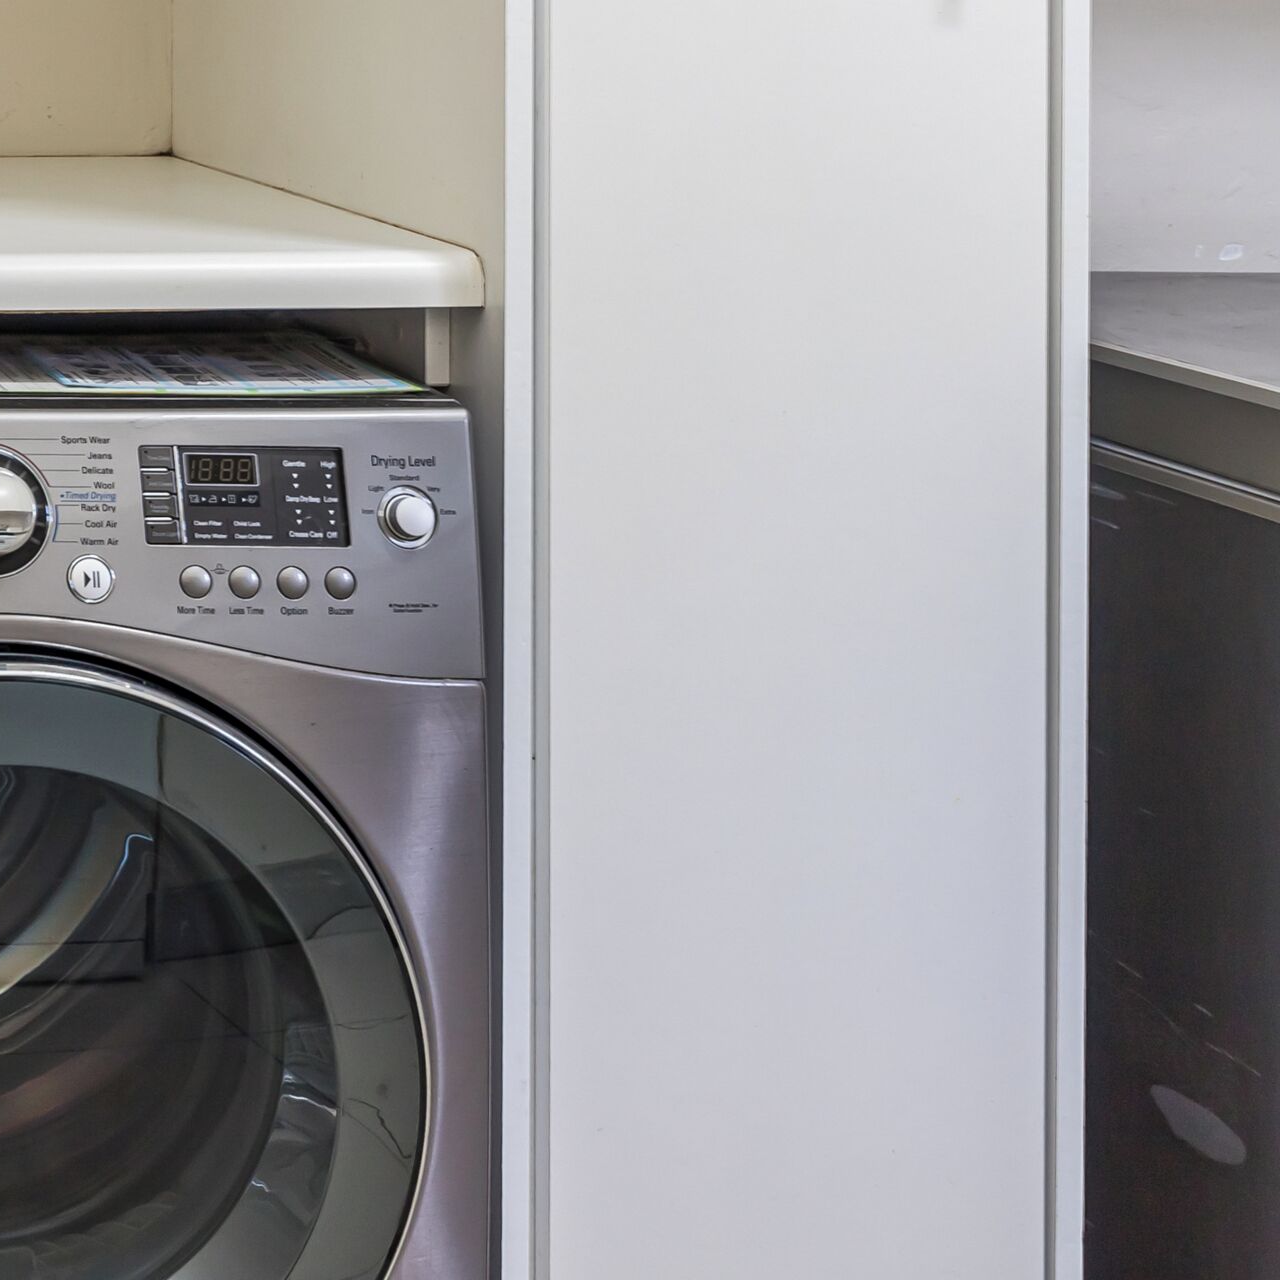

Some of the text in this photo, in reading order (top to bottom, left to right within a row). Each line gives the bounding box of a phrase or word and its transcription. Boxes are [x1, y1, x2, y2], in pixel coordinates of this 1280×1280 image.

[60, 436, 111, 445] Sports Wear
[87, 452, 112, 460] Jeans
[370, 455, 436, 469] Drying Level
[81, 466, 114, 474] Delicate
[65, 491, 117, 500] Timed Drying
[80, 504, 116, 513] Rack Dry
[85, 520, 118, 528] Cool Air
[80, 538, 119, 546] Warm Air
[177, 606, 215, 615] More Time
[229, 606, 264, 615] Less Time
[280, 606, 308, 616] Option
[328, 607, 354, 615] Buzzer
